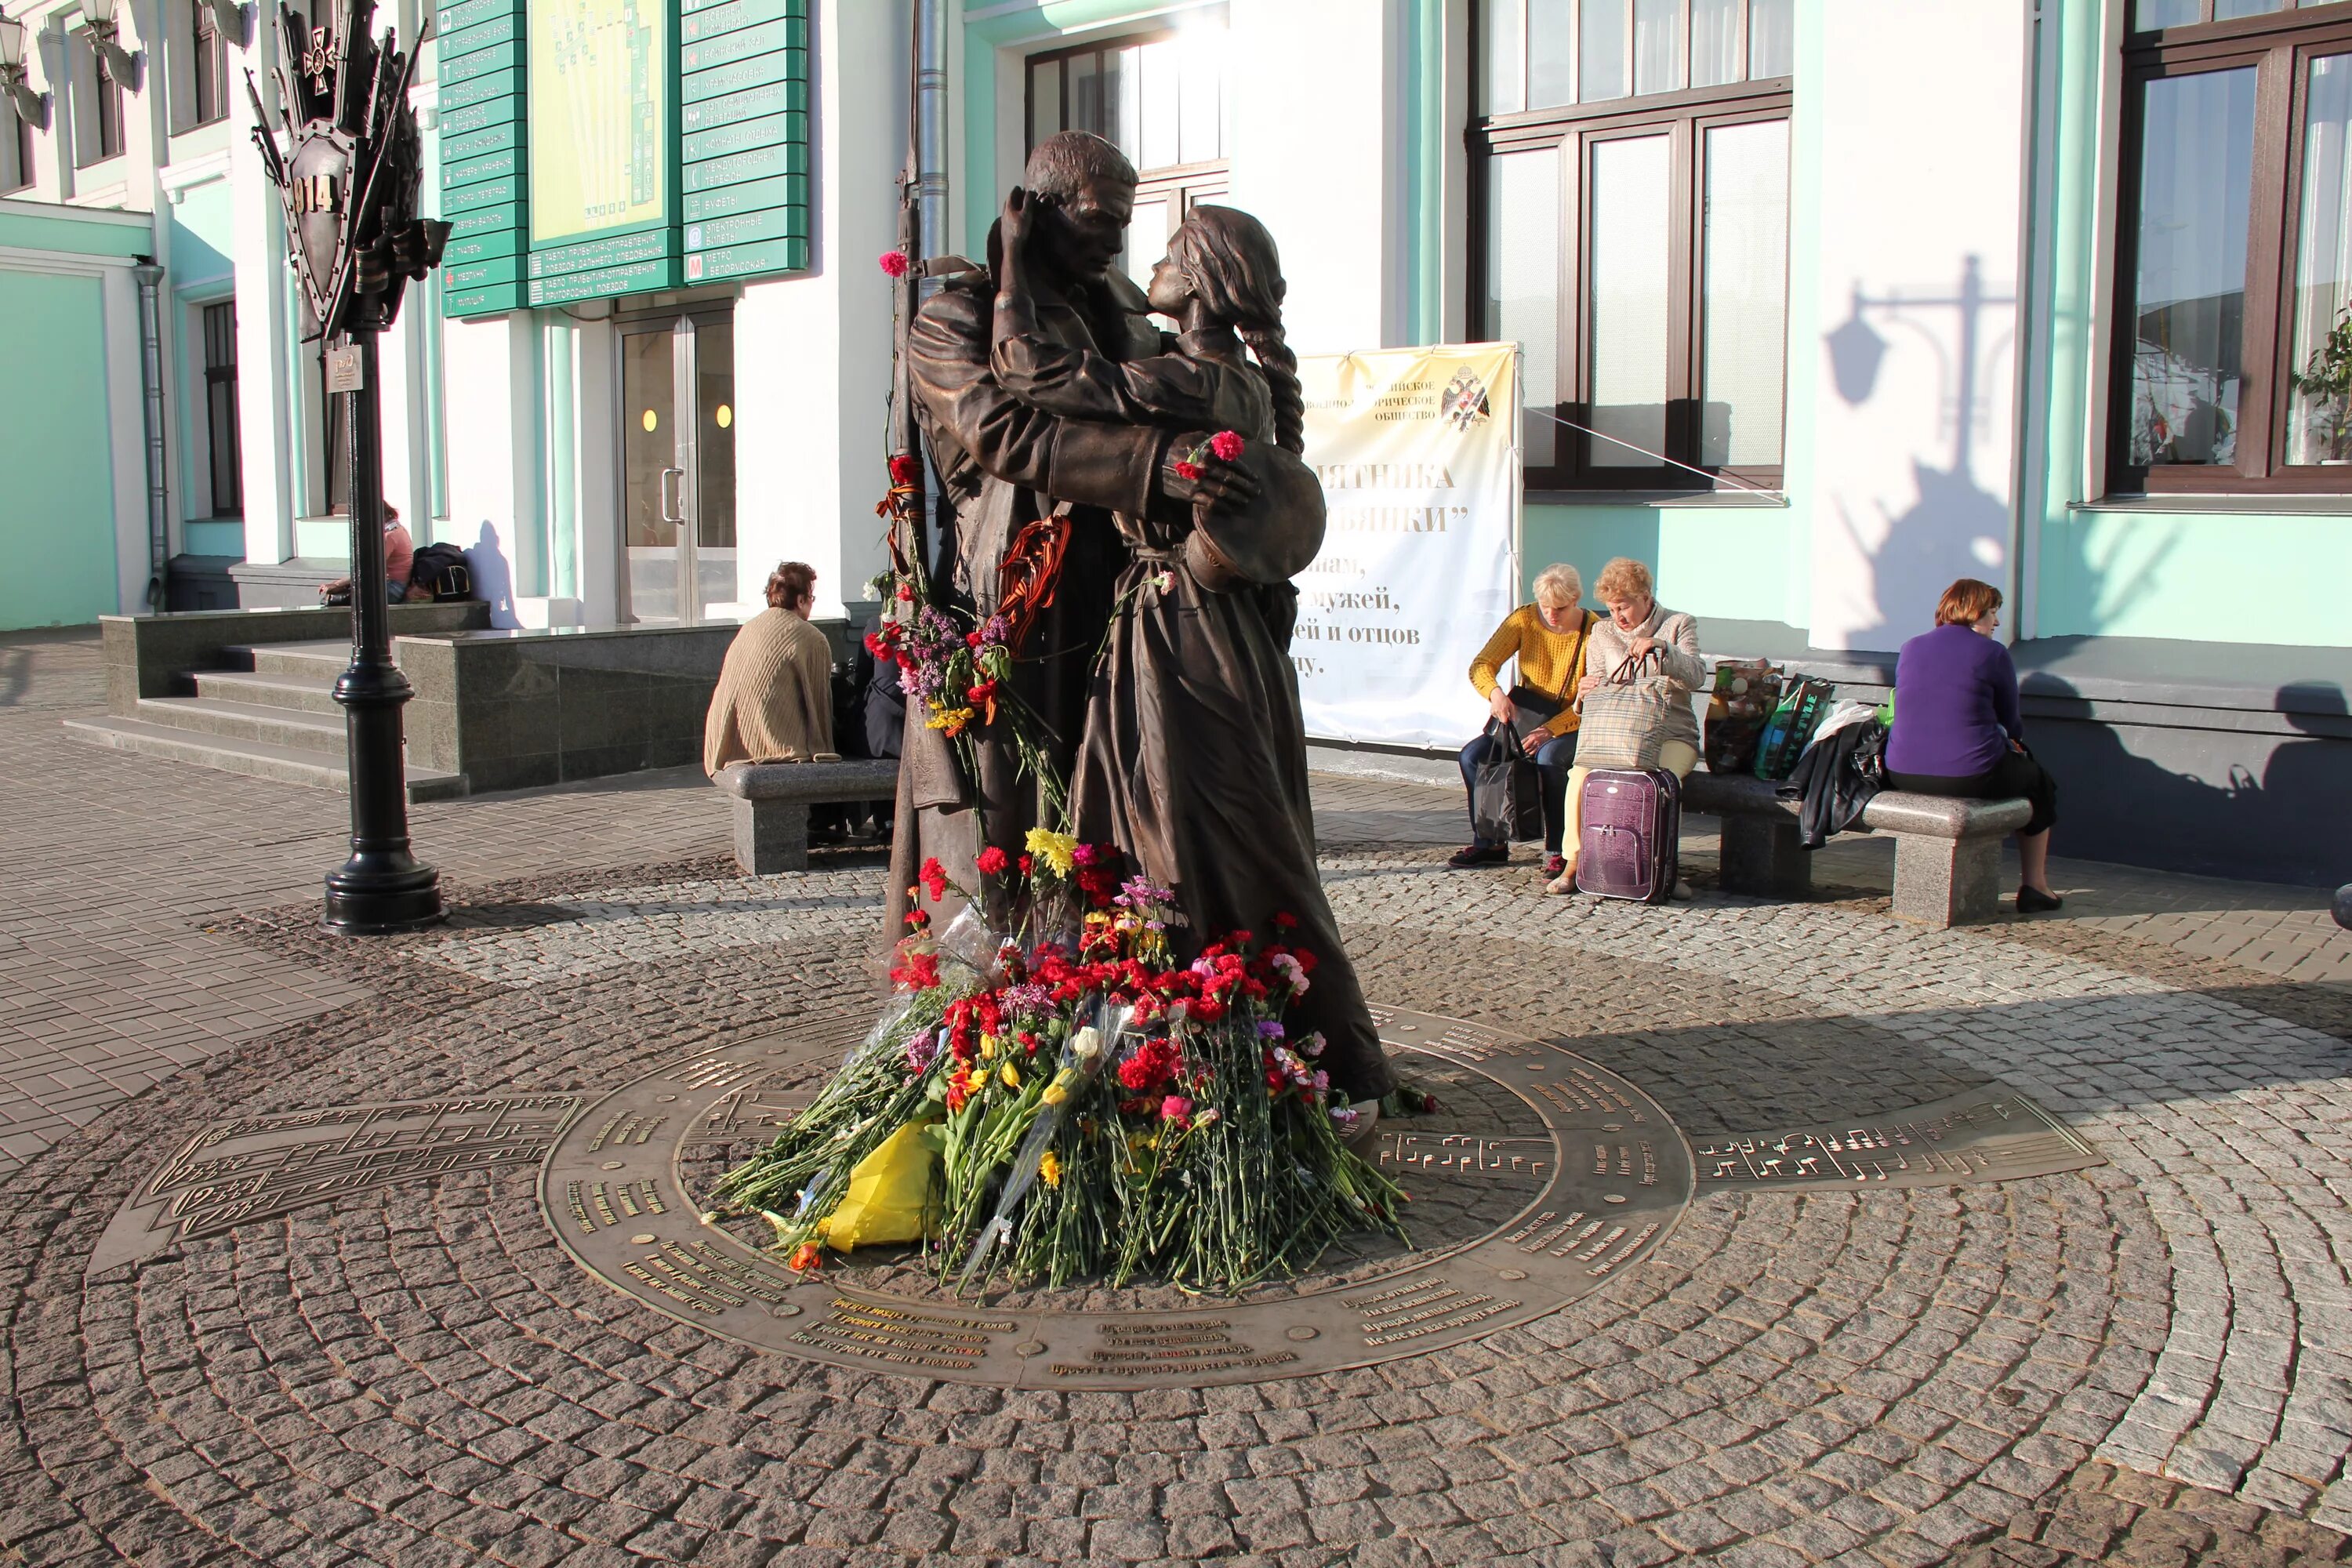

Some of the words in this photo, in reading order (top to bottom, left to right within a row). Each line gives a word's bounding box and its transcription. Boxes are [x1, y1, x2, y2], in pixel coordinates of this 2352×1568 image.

[455, 29, 491, 49] СПРАВОЧНОЕ
[492, 23, 511, 36] БЮРО
[702, 39, 746, 60] ВОИНСКИЙ
[748, 35, 766, 49] ЗАЛ
[721, 86, 781, 109] ОФИЦИАЛЬНЫХ
[703, 107, 748, 127] ДЕЛЕГАЦИЙ
[704, 133, 744, 151] КОМНАТЫ
[746, 125, 779, 141] ОТДЫХА
[706, 170, 742, 187] ТЕЛЕФОН
[705, 195, 738, 210] БУФЕТЫ
[706, 216, 764, 234] ЭЛЕКТРОННЫЕ
[706, 231, 737, 247] БИЛЕТЫ
[545, 250, 566, 262] ТАБЛО
[545, 260, 575, 277] ПОЕЗДОВ
[579, 253, 614, 271] ДАЛЬНЕГО
[616, 245, 663, 264] СЛЕДОВАНИЯ
[706, 250, 732, 263] МЕТРО
[545, 278, 566, 290] ТАБЛО
[545, 287, 593, 303] ПРИГОРОДНЫХ
[597, 280, 629, 294] ПОЕЗДОВ
[1374, 411, 1436, 423] ОБЩЕСТВО
[1310, 586, 1400, 615] мужей,
[1327, 626, 1342, 642] и
[1348, 626, 1421, 649] отцов
[1364, 1337, 1385, 1345] Не
[1385, 1332, 1408, 1341] все
[1407, 1328, 1425, 1337] из
[1423, 1322, 1446, 1332] нас
[1446, 1310, 1486, 1327] придут
[1484, 1299, 1519, 1313] назад.
[817, 1325, 850, 1336] зовет
[850, 1332, 873, 1341] нас
[873, 1336, 890, 1345] на
[890, 1339, 932, 1350] подвиг
[938, 1344, 983, 1356] Россия,
